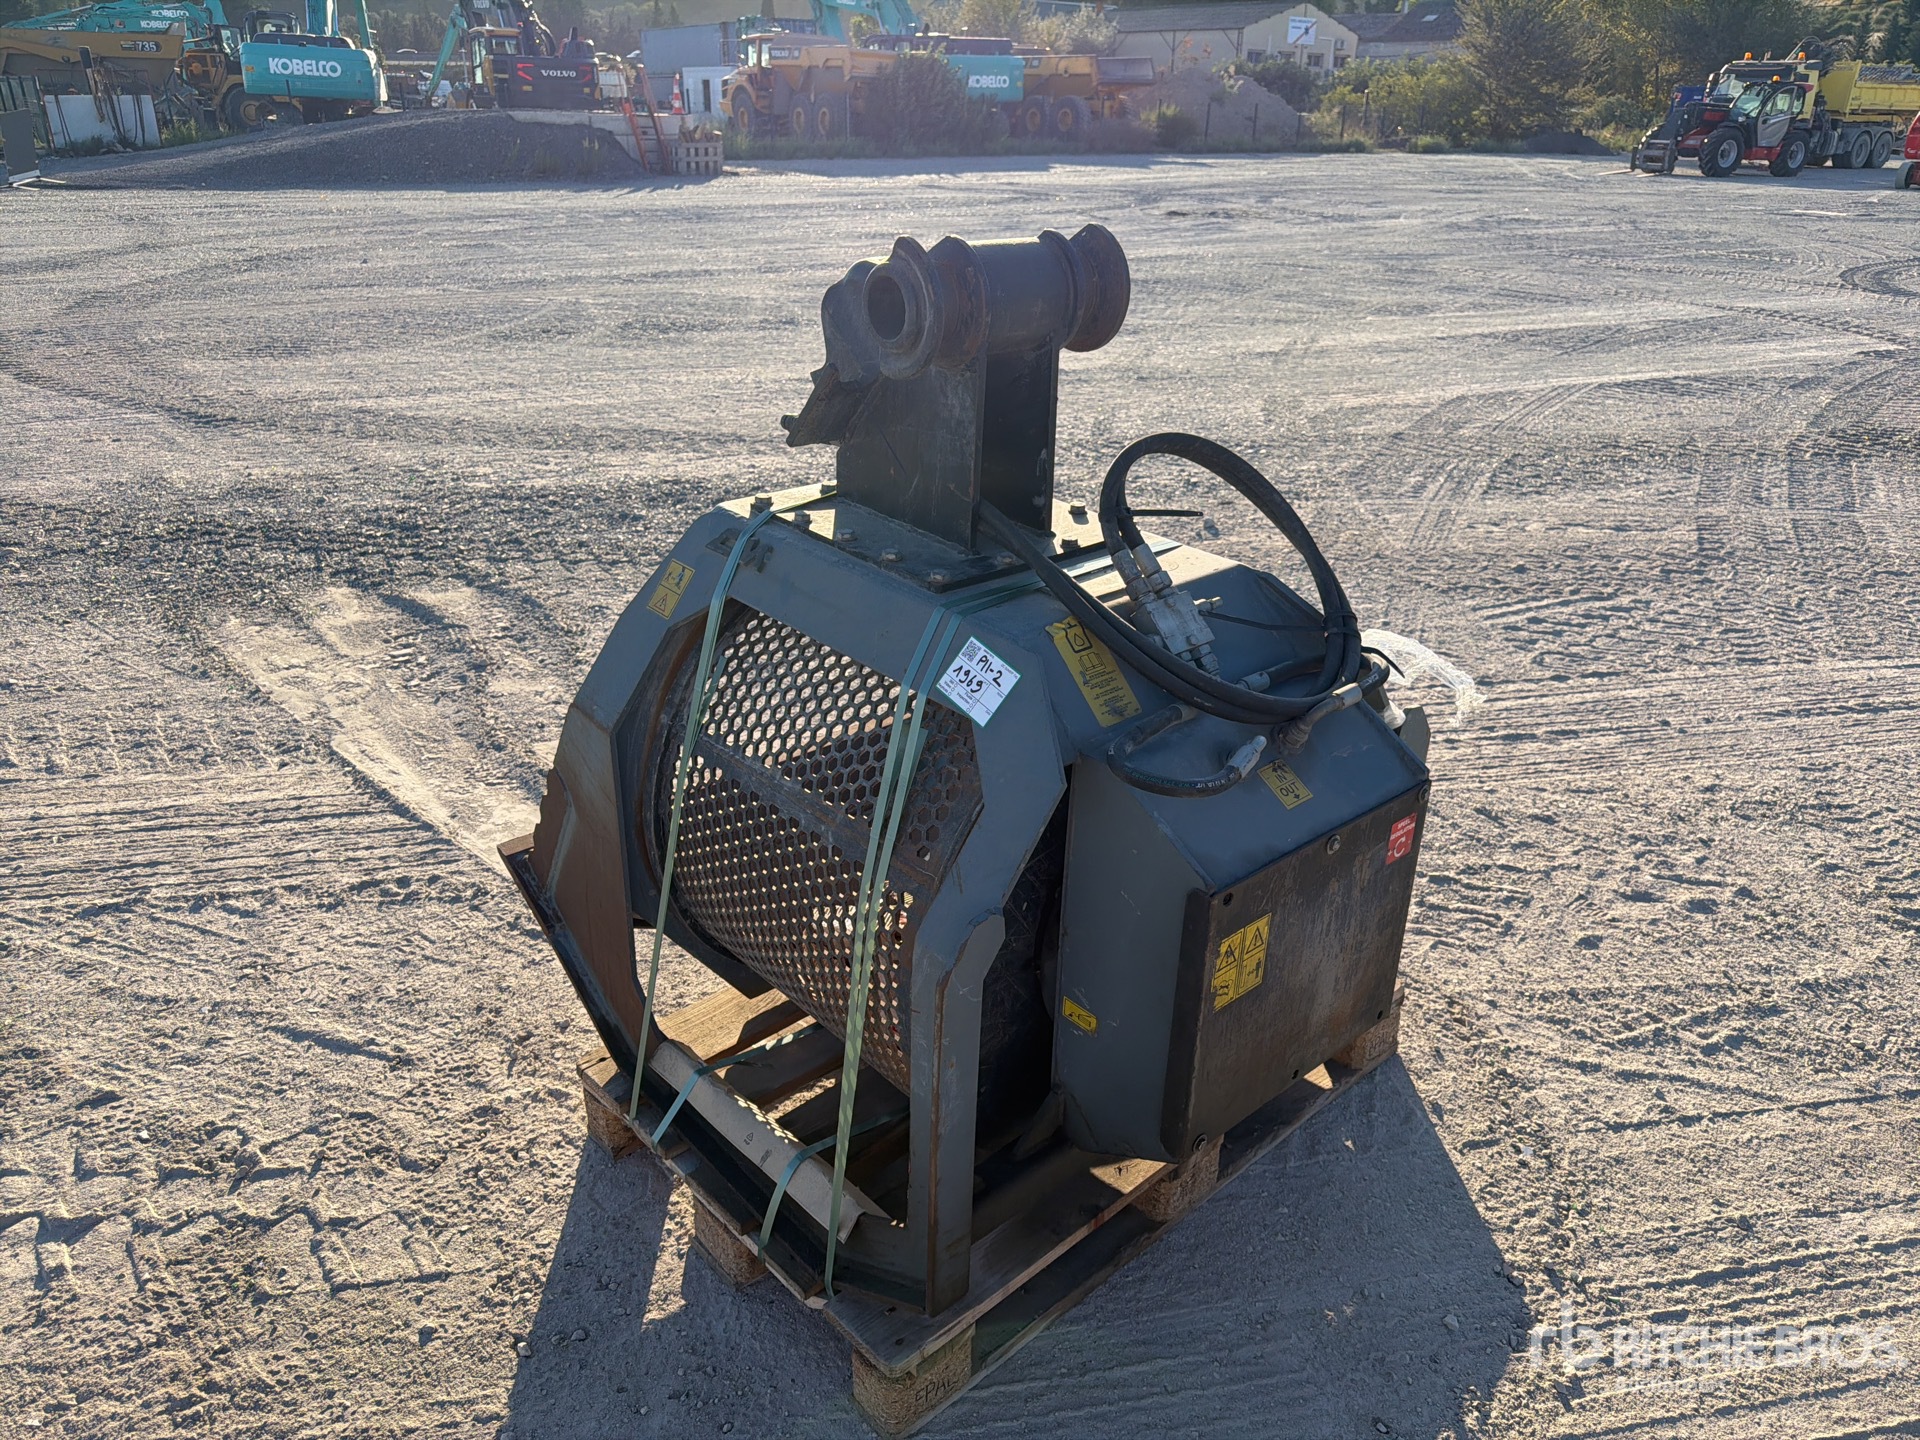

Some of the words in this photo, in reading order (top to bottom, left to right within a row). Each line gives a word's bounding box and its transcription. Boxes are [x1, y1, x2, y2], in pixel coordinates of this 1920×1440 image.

[136, 41, 157, 52] 735
[268, 57, 342, 78] KOBELCO
[540, 69, 577, 78] VOLVO
[968, 75, 1010, 88] KOBELCO
[952, 665, 984, 694] 1969
[1274, 772, 1288, 784] IN
[1279, 781, 1300, 797] OUT
